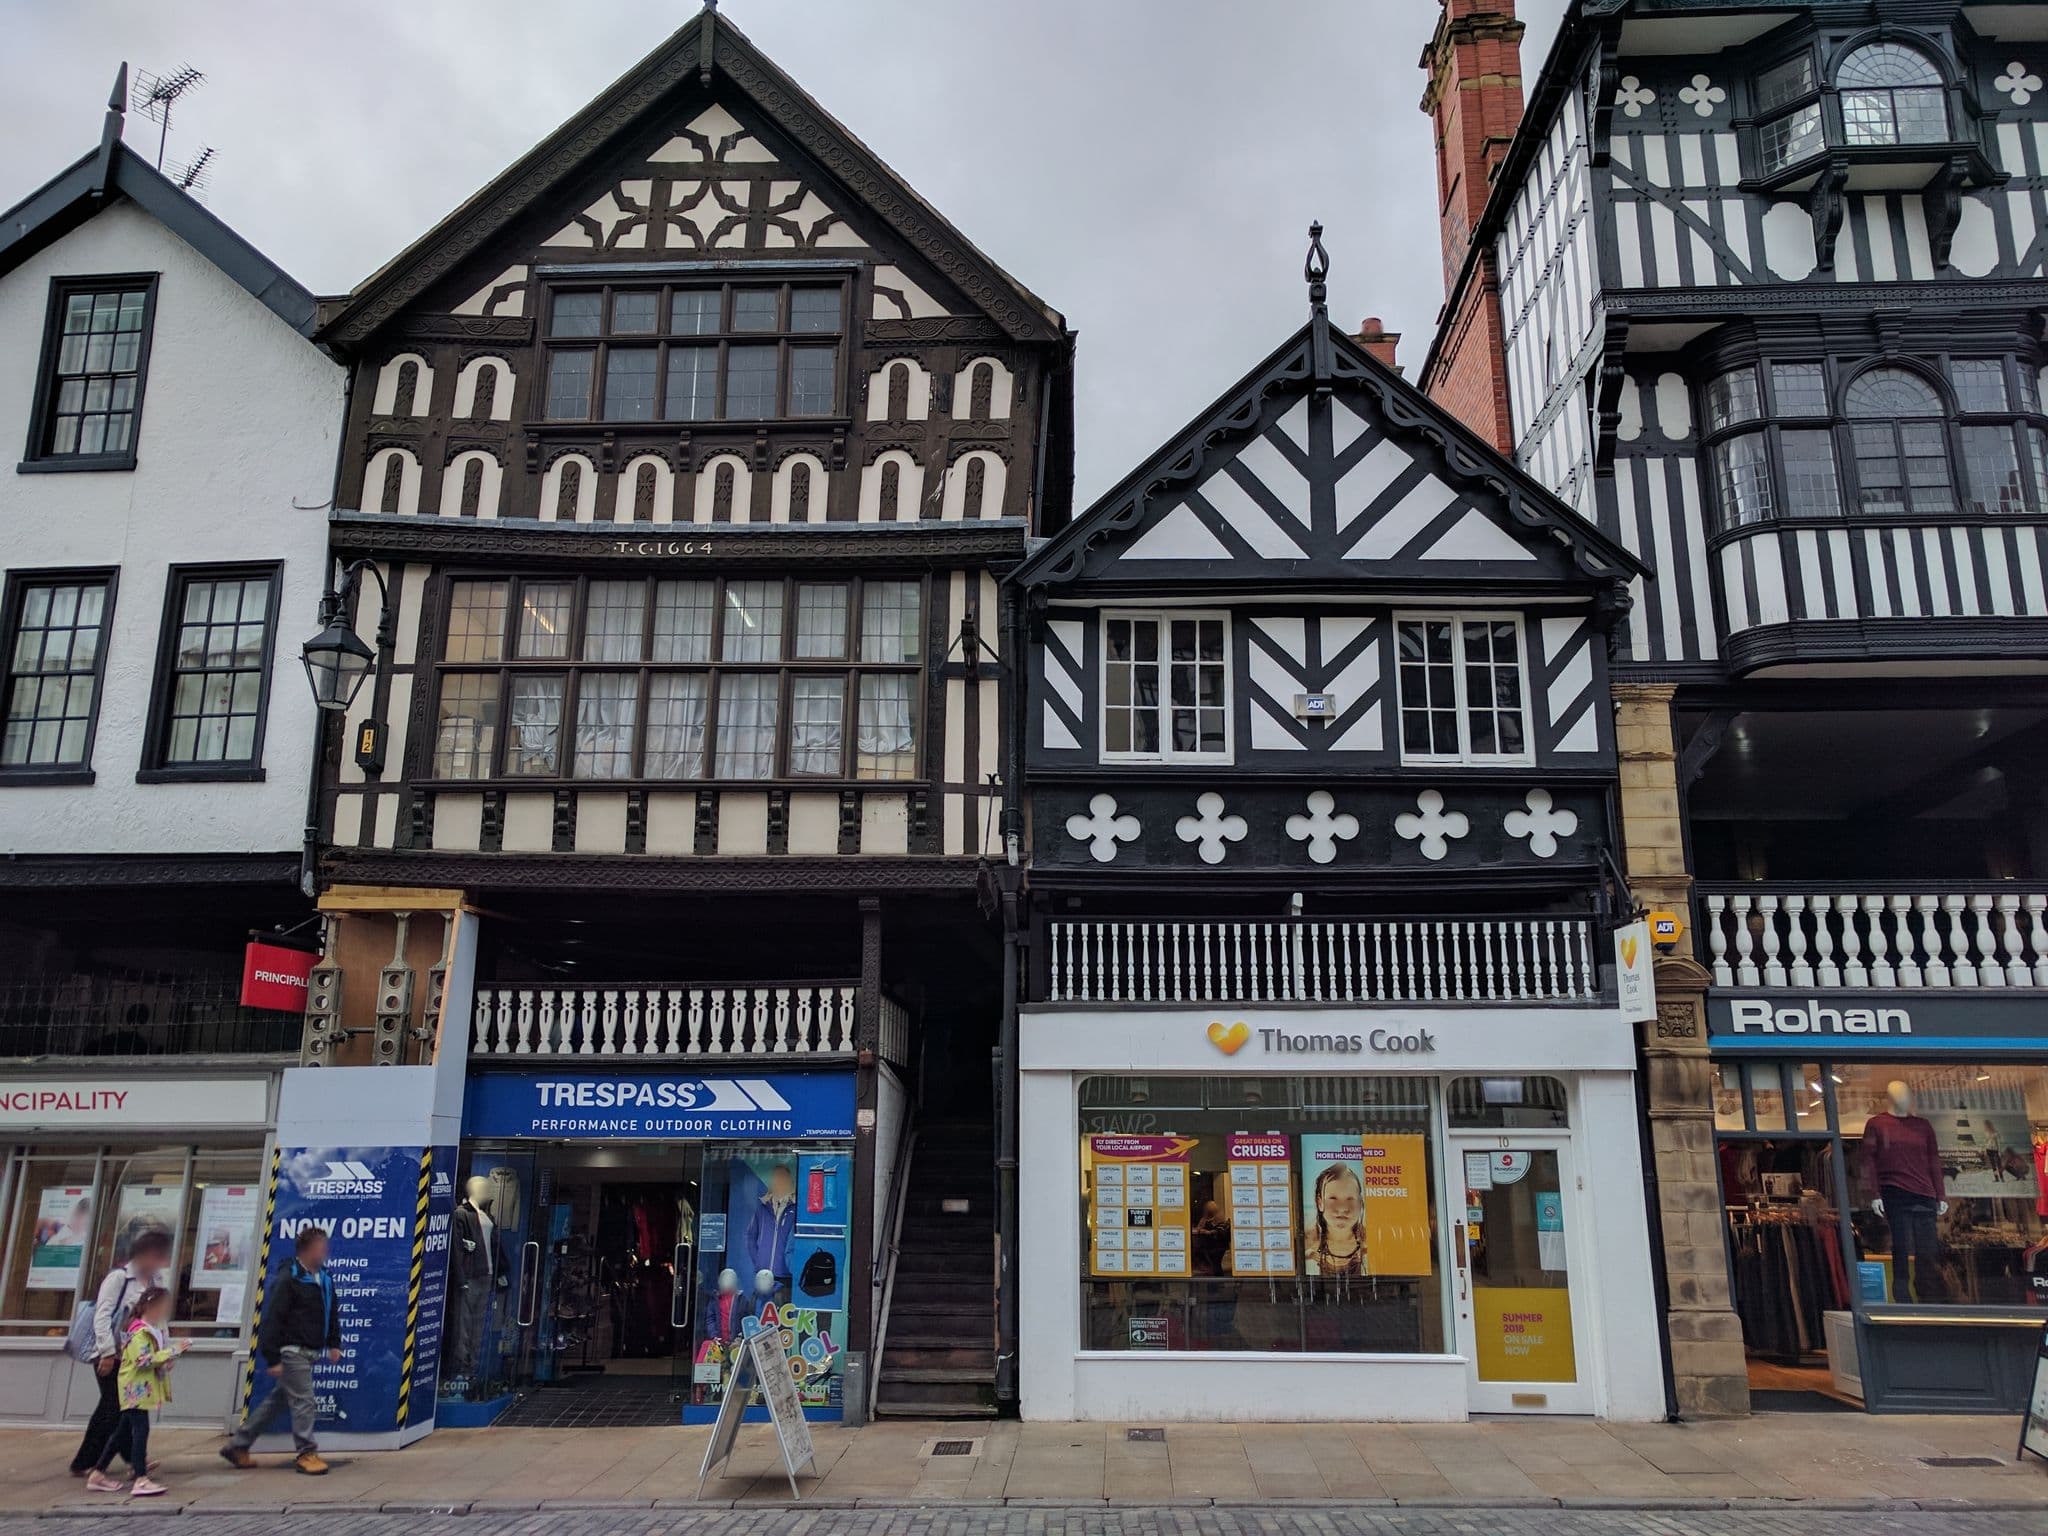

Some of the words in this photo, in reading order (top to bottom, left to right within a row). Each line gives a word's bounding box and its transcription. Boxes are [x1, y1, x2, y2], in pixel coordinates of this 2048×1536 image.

[1308, 700, 1325, 709] ADT
[1657, 922, 1674, 932] ADT
[1731, 1000, 1912, 1033] Rohan
[1259, 1029, 1362, 1051] Thomas
[1370, 1029, 1435, 1051] Cook
[536, 1083, 697, 1107] TRESPASS
[532, 1120, 637, 1130] PERFORMANCE
[645, 1120, 712, 1130] OUTDOOR
[720, 1120, 792, 1130] CLOTHING
[1498, 1137, 1509, 1147] 10
[1232, 1145, 1285, 1157] CRUISES
[1365, 1166, 1402, 1174] ONLINE
[1365, 1177, 1399, 1186] PRICES
[308, 1181, 383, 1193] TRESPASS
[1366, 1188, 1408, 1197] INSTORE
[280, 1218, 337, 1239] NOW
[342, 1217, 406, 1239] OPEN
[429, 1214, 450, 1232] NOW
[425, 1234, 448, 1252] OPEN
[335, 1288, 377, 1297] SPORT
[742, 1302, 817, 1340] BACK
[1503, 1314, 1543, 1322] SUMMER
[1504, 1335, 1519, 1344] ON
[1521, 1335, 1544, 1344] SALE
[1504, 1346, 1529, 1355] NOW
